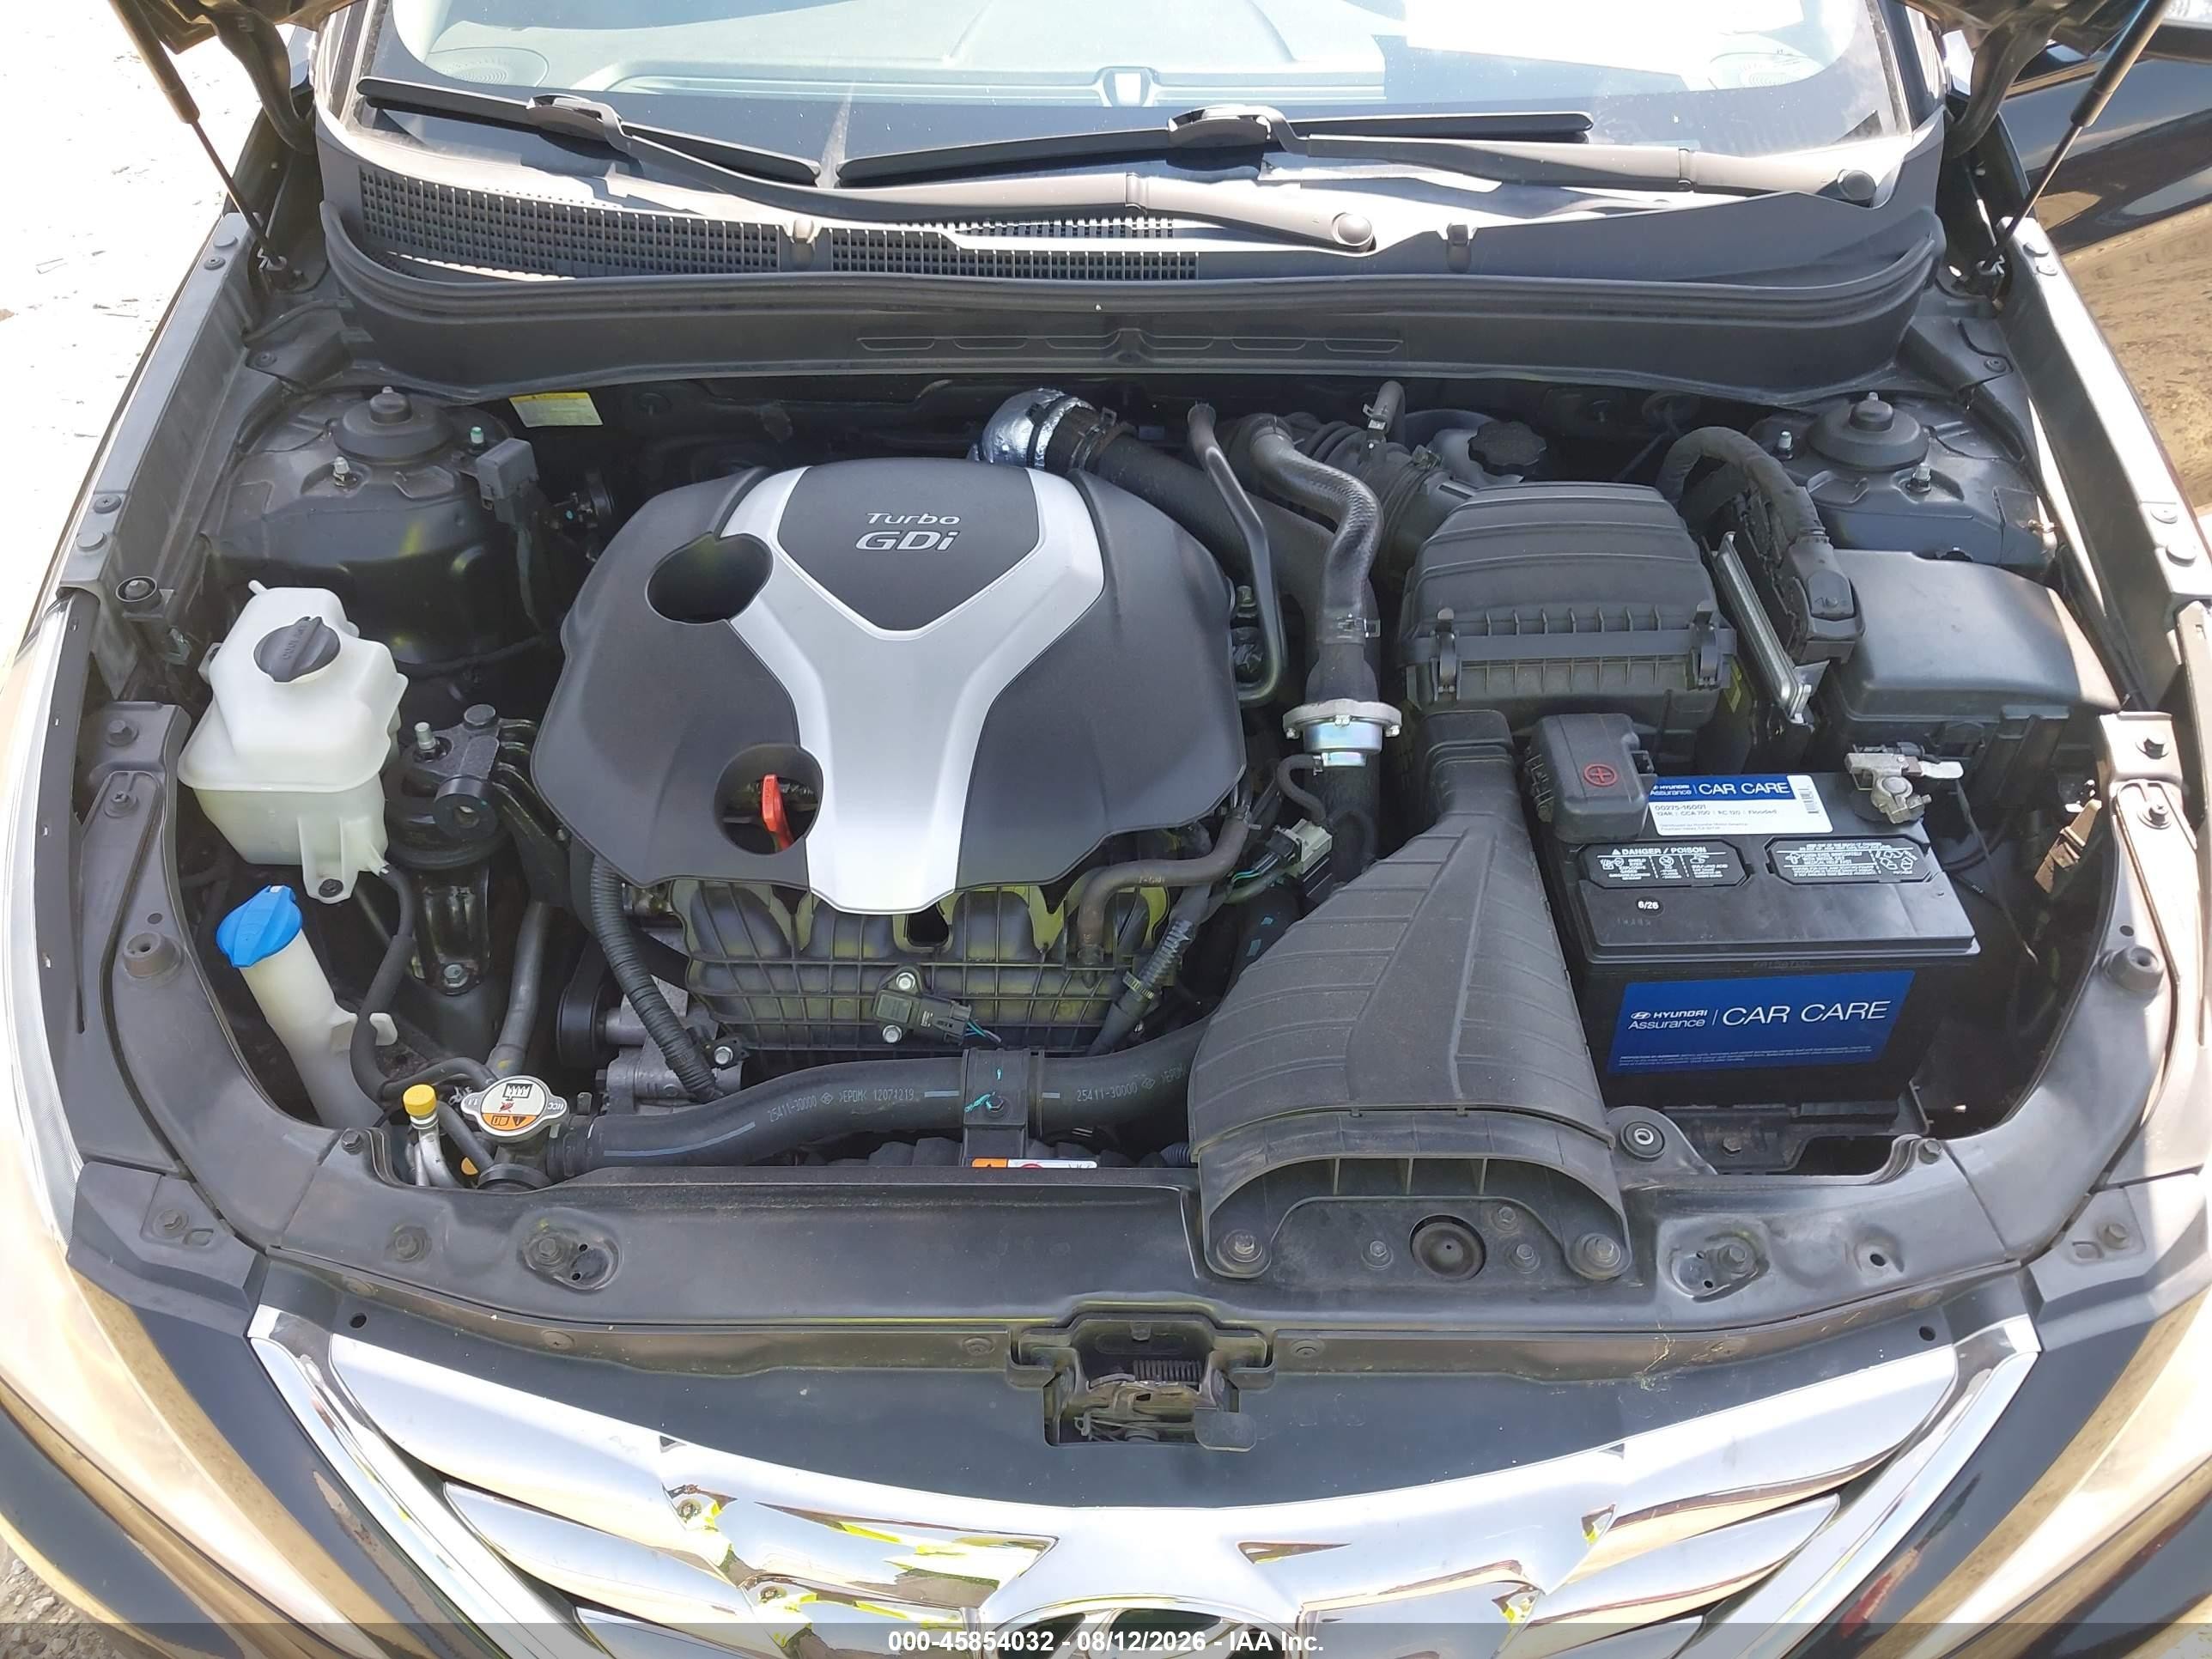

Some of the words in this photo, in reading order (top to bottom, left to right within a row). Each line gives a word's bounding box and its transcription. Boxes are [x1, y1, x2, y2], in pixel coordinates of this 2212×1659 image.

[866, 513, 961, 525] Turbo
[855, 531, 960, 550] GDi
[1698, 783, 1736, 795] CAR
[1741, 782, 1790, 794] CARE
[1653, 1010, 1708, 1018] HYUNDAI
[1723, 1006, 1790, 1026] CAR
[1801, 1000, 1891, 1022] CARE
[1628, 1019, 1705, 1030] Assurance
